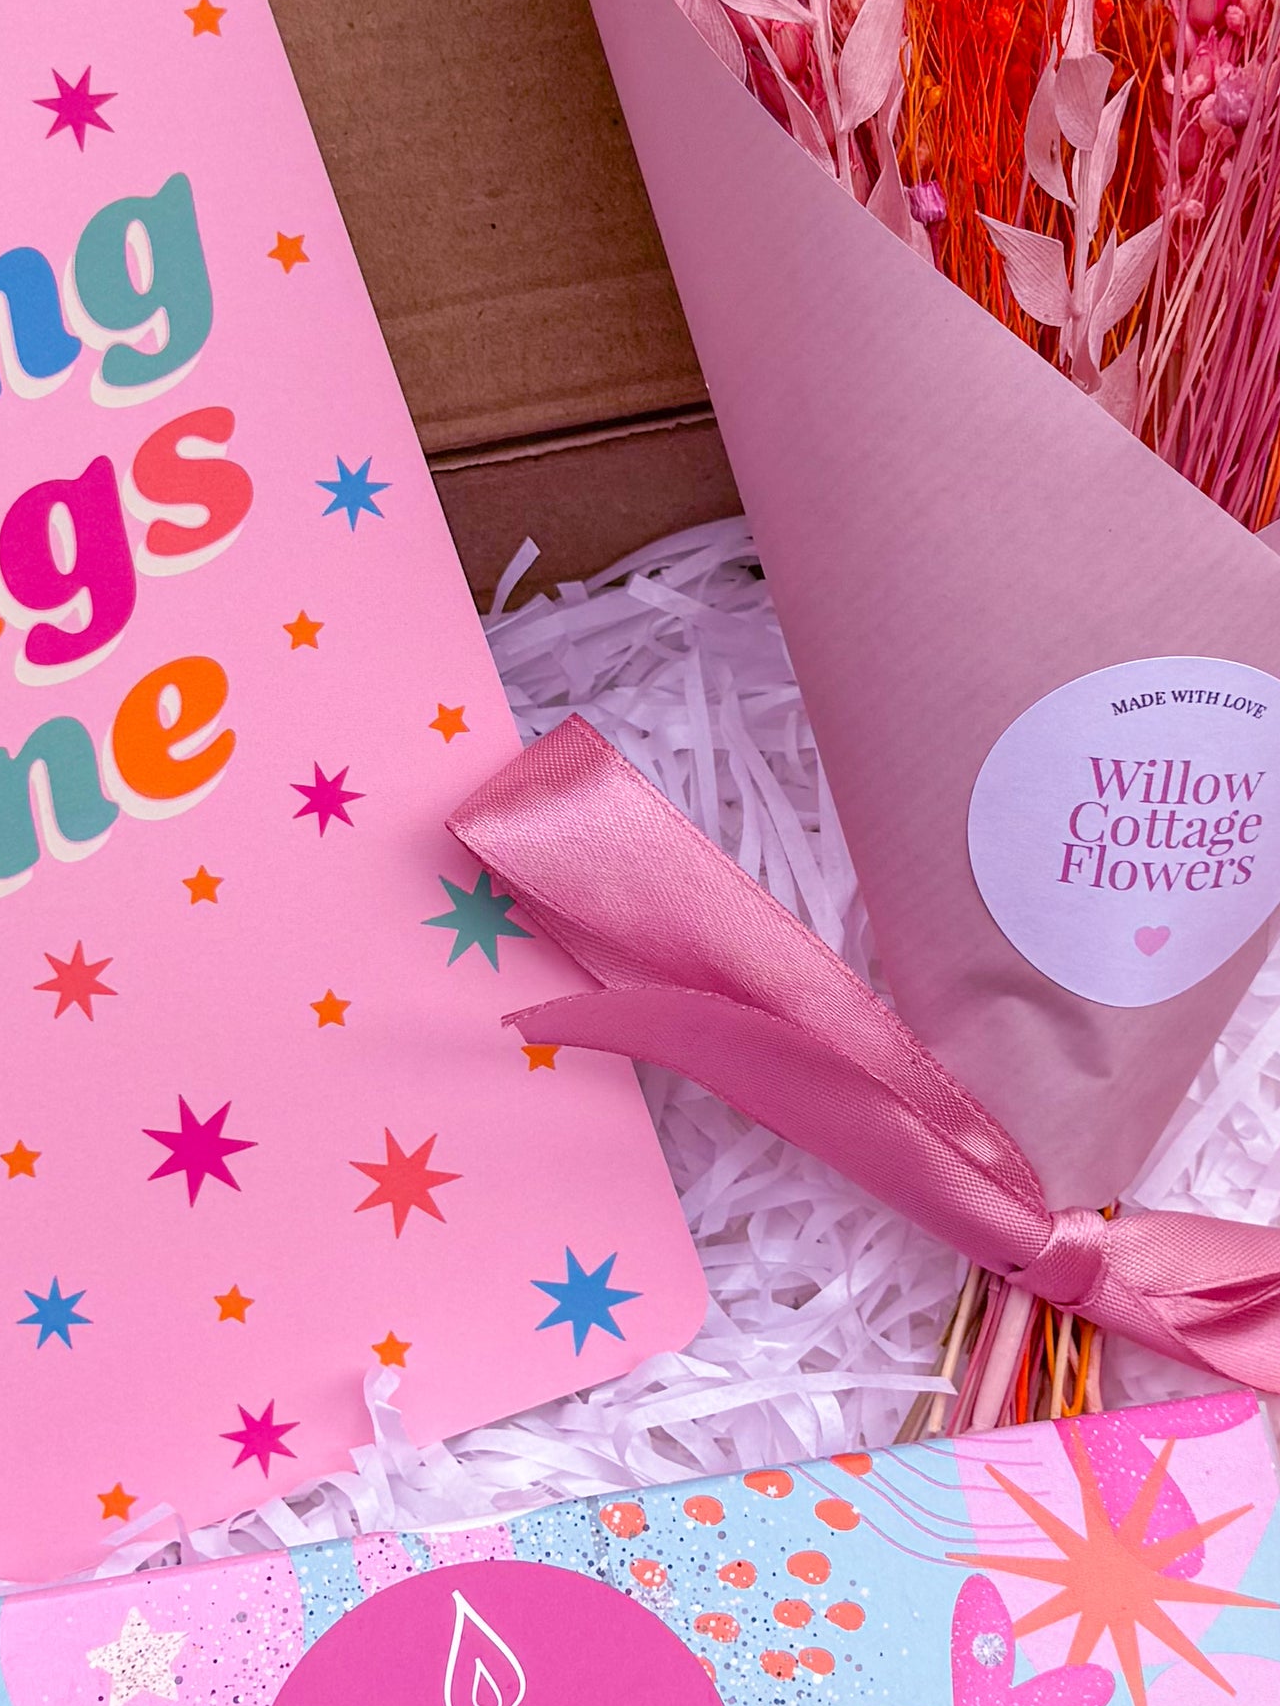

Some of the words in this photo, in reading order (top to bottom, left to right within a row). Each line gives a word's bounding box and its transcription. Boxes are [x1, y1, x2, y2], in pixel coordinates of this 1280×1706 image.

[1111, 690, 1167, 716] MADE
[1170, 689, 1221, 706] WITH
[1222, 693, 1268, 720] LOVE
[1088, 756, 1266, 805] Willow
[1068, 800, 1263, 857] Cottage
[1056, 841, 1256, 892] Flowers
